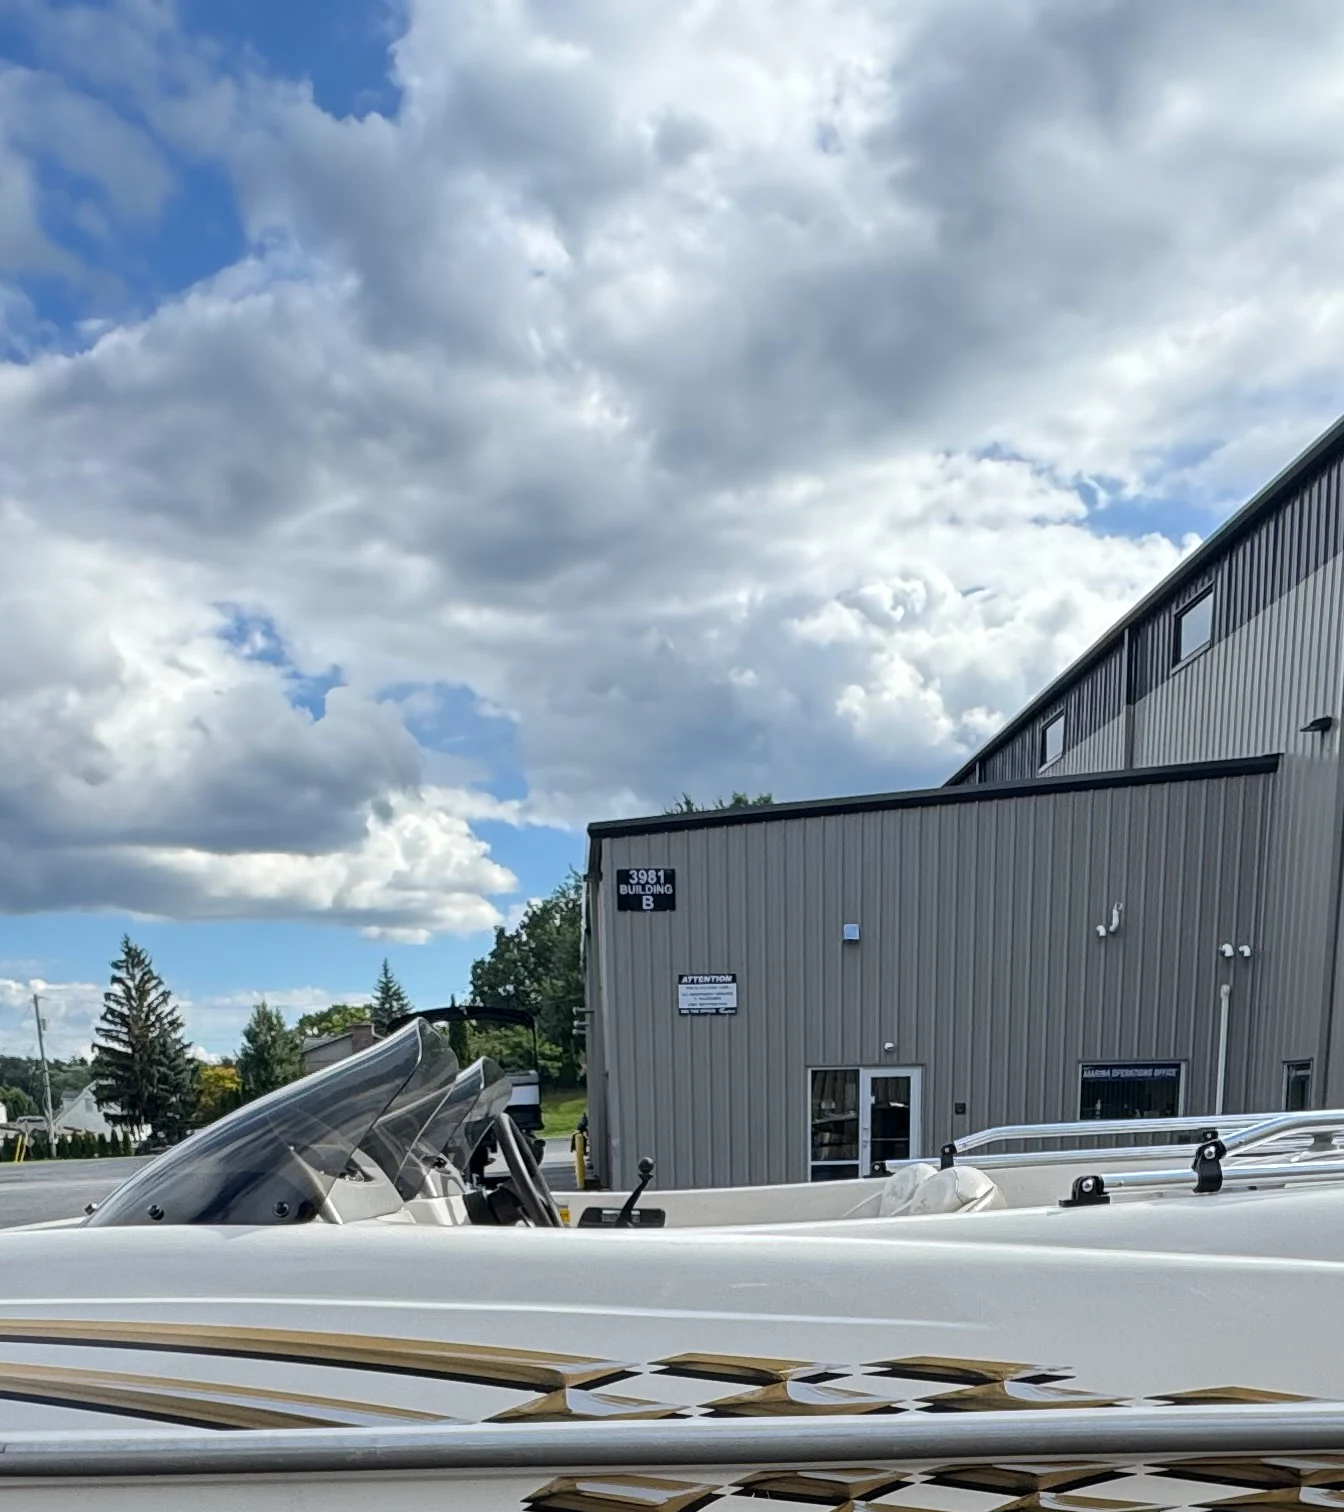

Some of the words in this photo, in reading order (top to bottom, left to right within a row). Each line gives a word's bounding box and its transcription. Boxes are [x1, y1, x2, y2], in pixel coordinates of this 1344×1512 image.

[629, 869, 665, 884] 3981
[619, 884, 673, 895] BUILDING
[642, 895, 654, 910] B
[681, 975, 733, 984] ATTENTION
